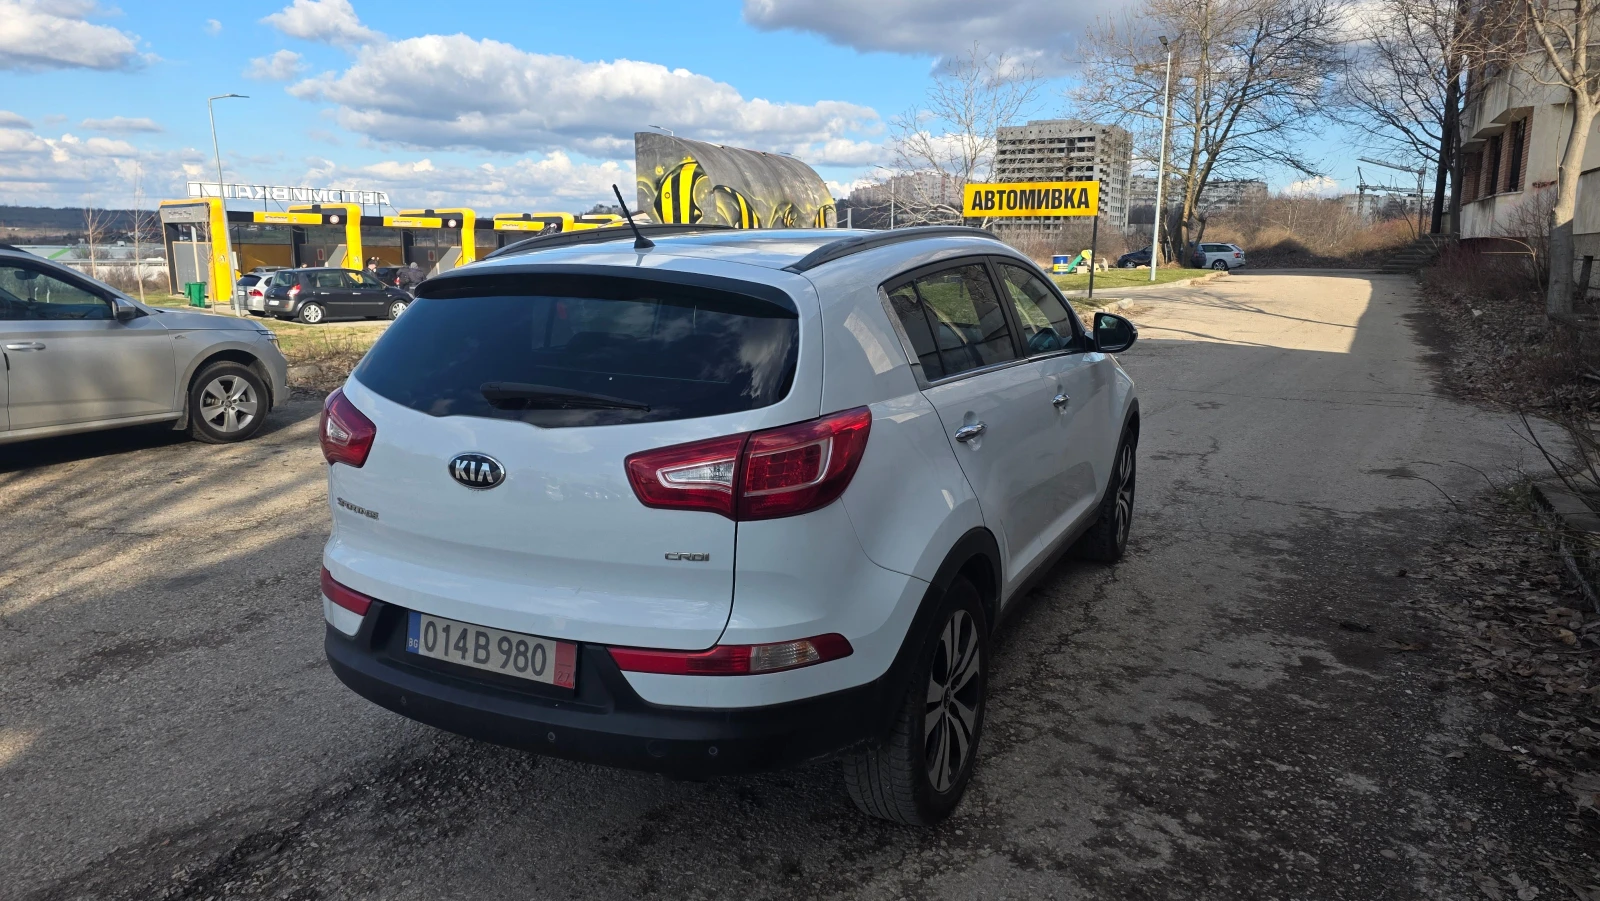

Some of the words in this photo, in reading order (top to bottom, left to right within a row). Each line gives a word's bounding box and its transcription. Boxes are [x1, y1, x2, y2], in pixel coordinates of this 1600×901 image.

[971, 188, 1090, 210] АВТОМИВКА
[454, 459, 494, 483] KIA
[408, 637, 419, 649] BG
